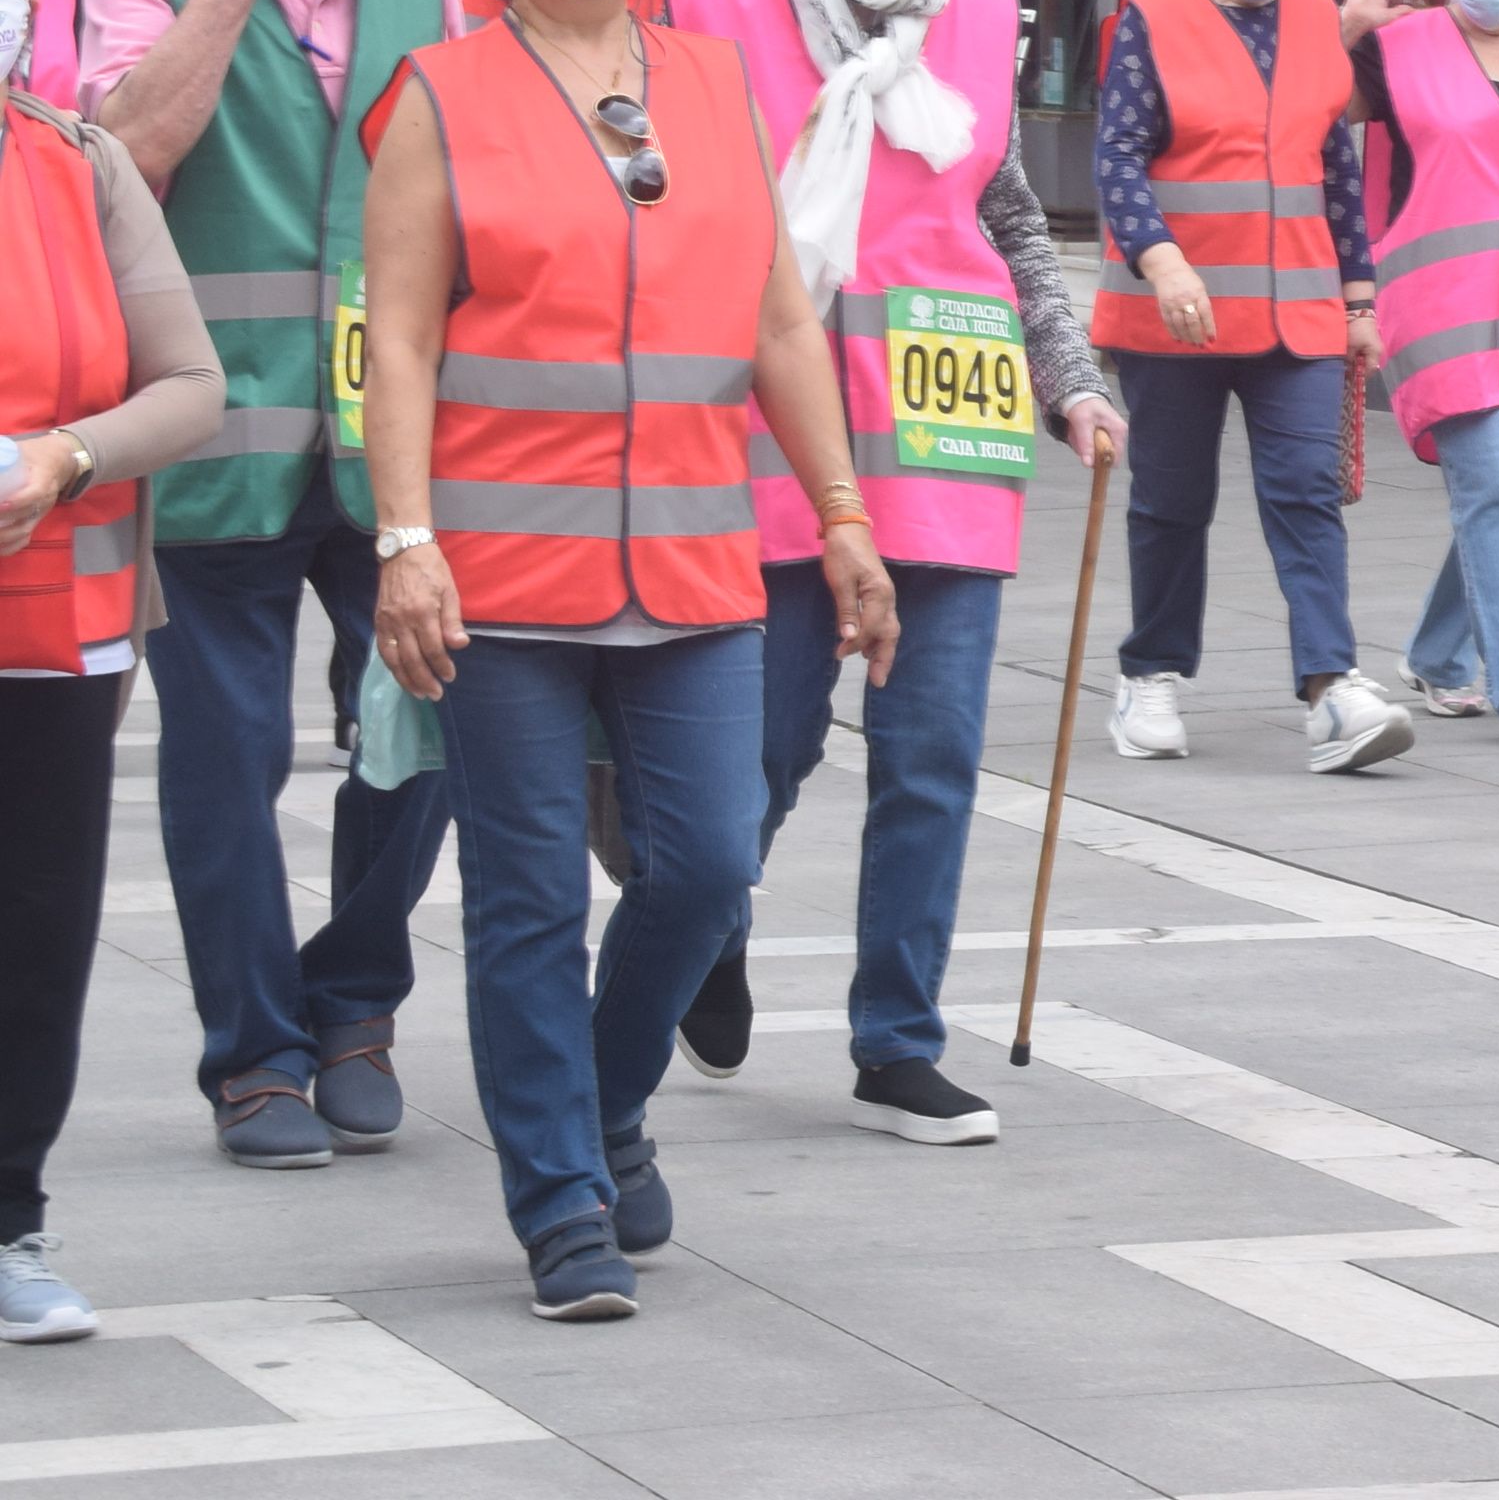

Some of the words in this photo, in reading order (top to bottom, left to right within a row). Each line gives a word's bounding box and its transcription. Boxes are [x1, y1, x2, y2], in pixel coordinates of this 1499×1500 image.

[938, 315, 969, 333] CAJA
[972, 320, 1012, 339] RURAL
[903, 344, 1018, 420] 0949
[938, 437, 977, 457] CAJA
[978, 441, 1030, 463] RURAL
